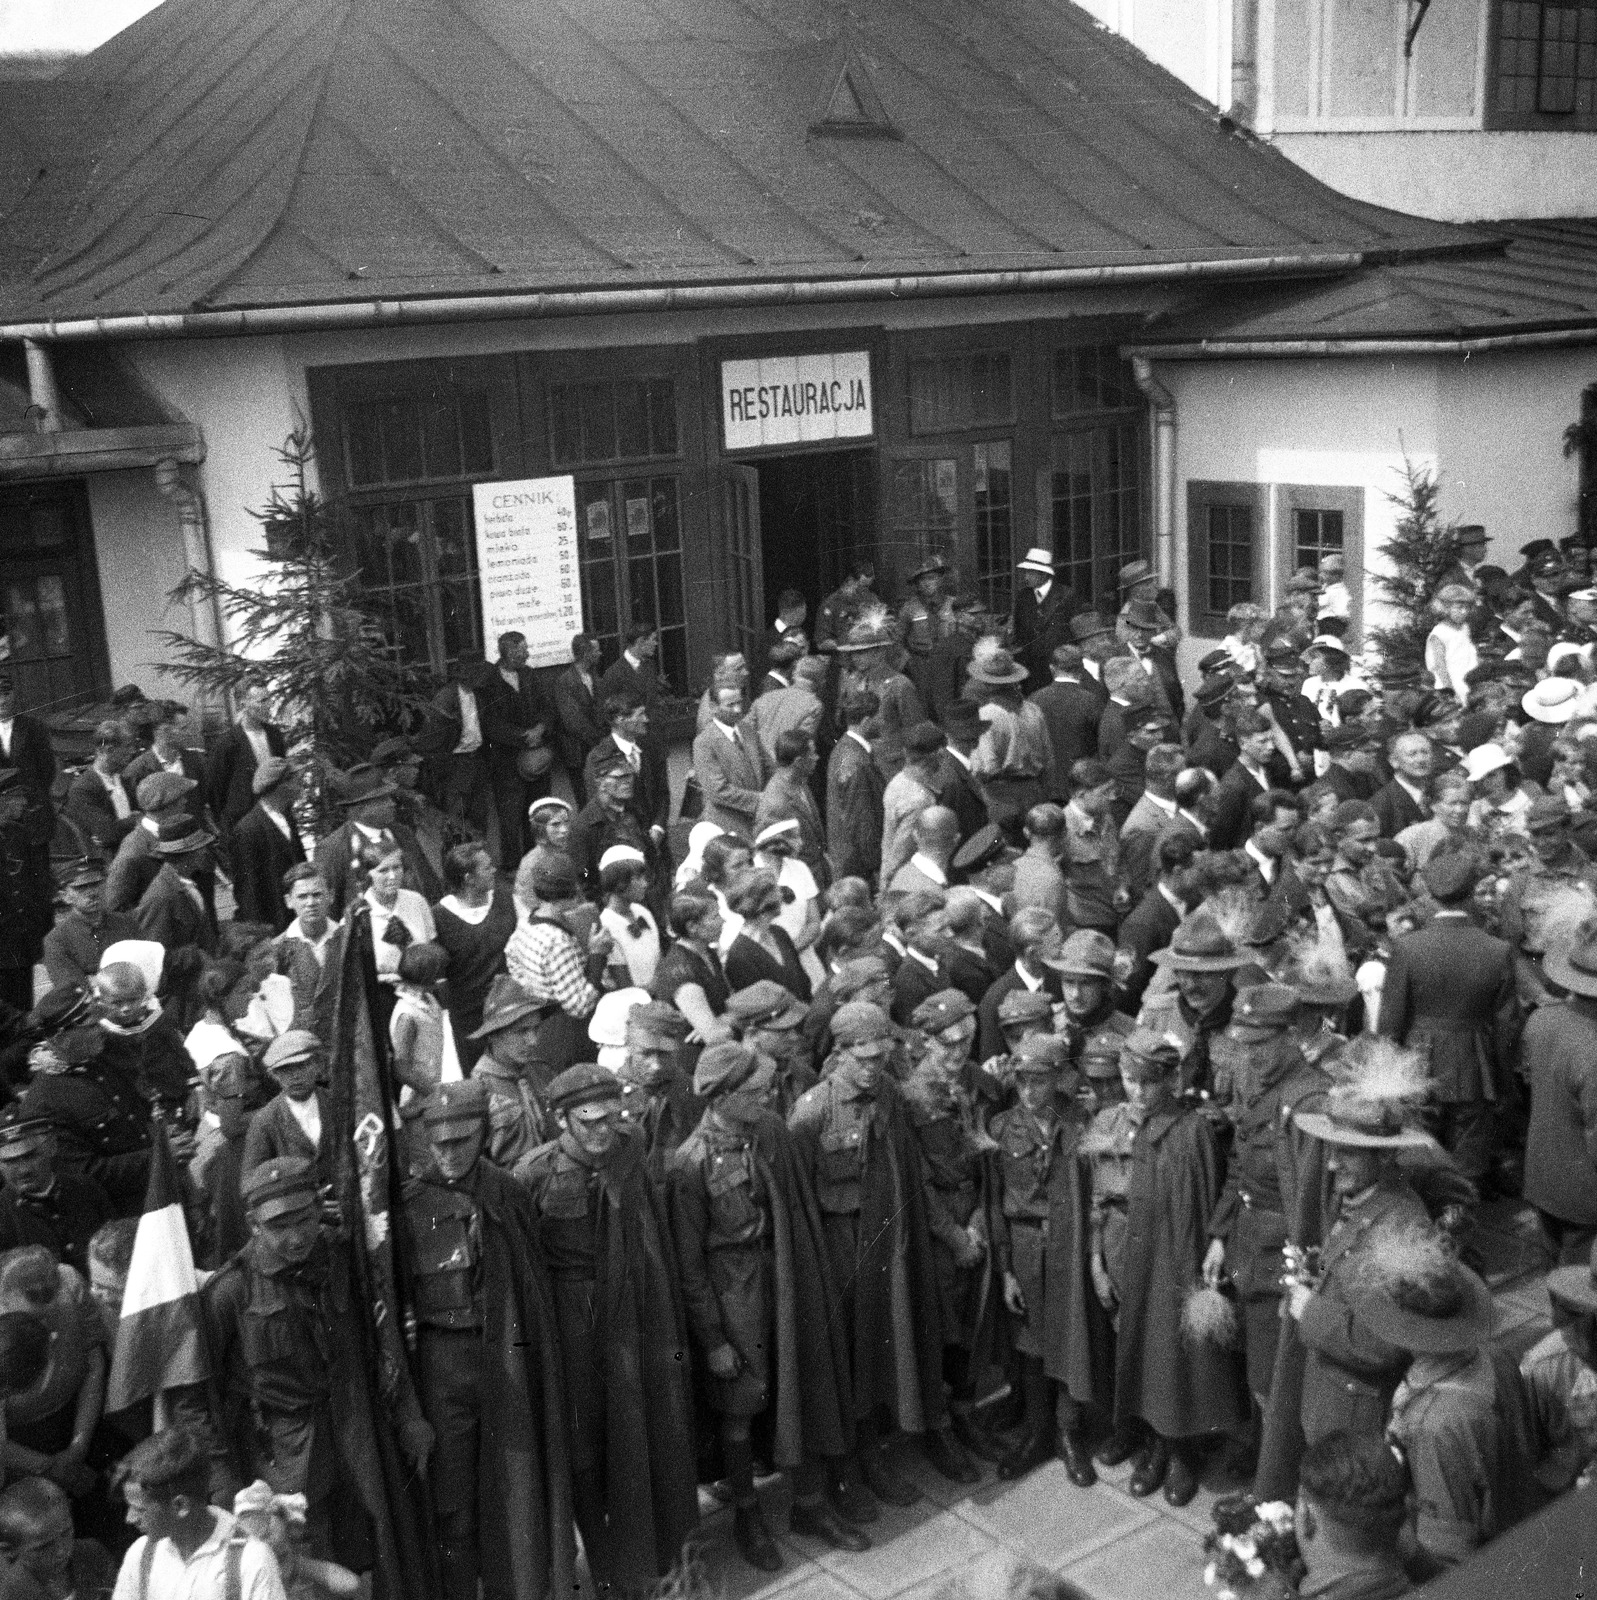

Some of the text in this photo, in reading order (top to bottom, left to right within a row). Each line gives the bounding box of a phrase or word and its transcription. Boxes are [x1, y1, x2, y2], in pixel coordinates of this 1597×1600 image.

[729, 379, 866, 422] RESTAURACJA
[492, 491, 554, 509] CENNIK
[486, 542, 519, 554] mleko
[487, 556, 538, 569] lemoniada
[489, 589, 513, 602] piwo
